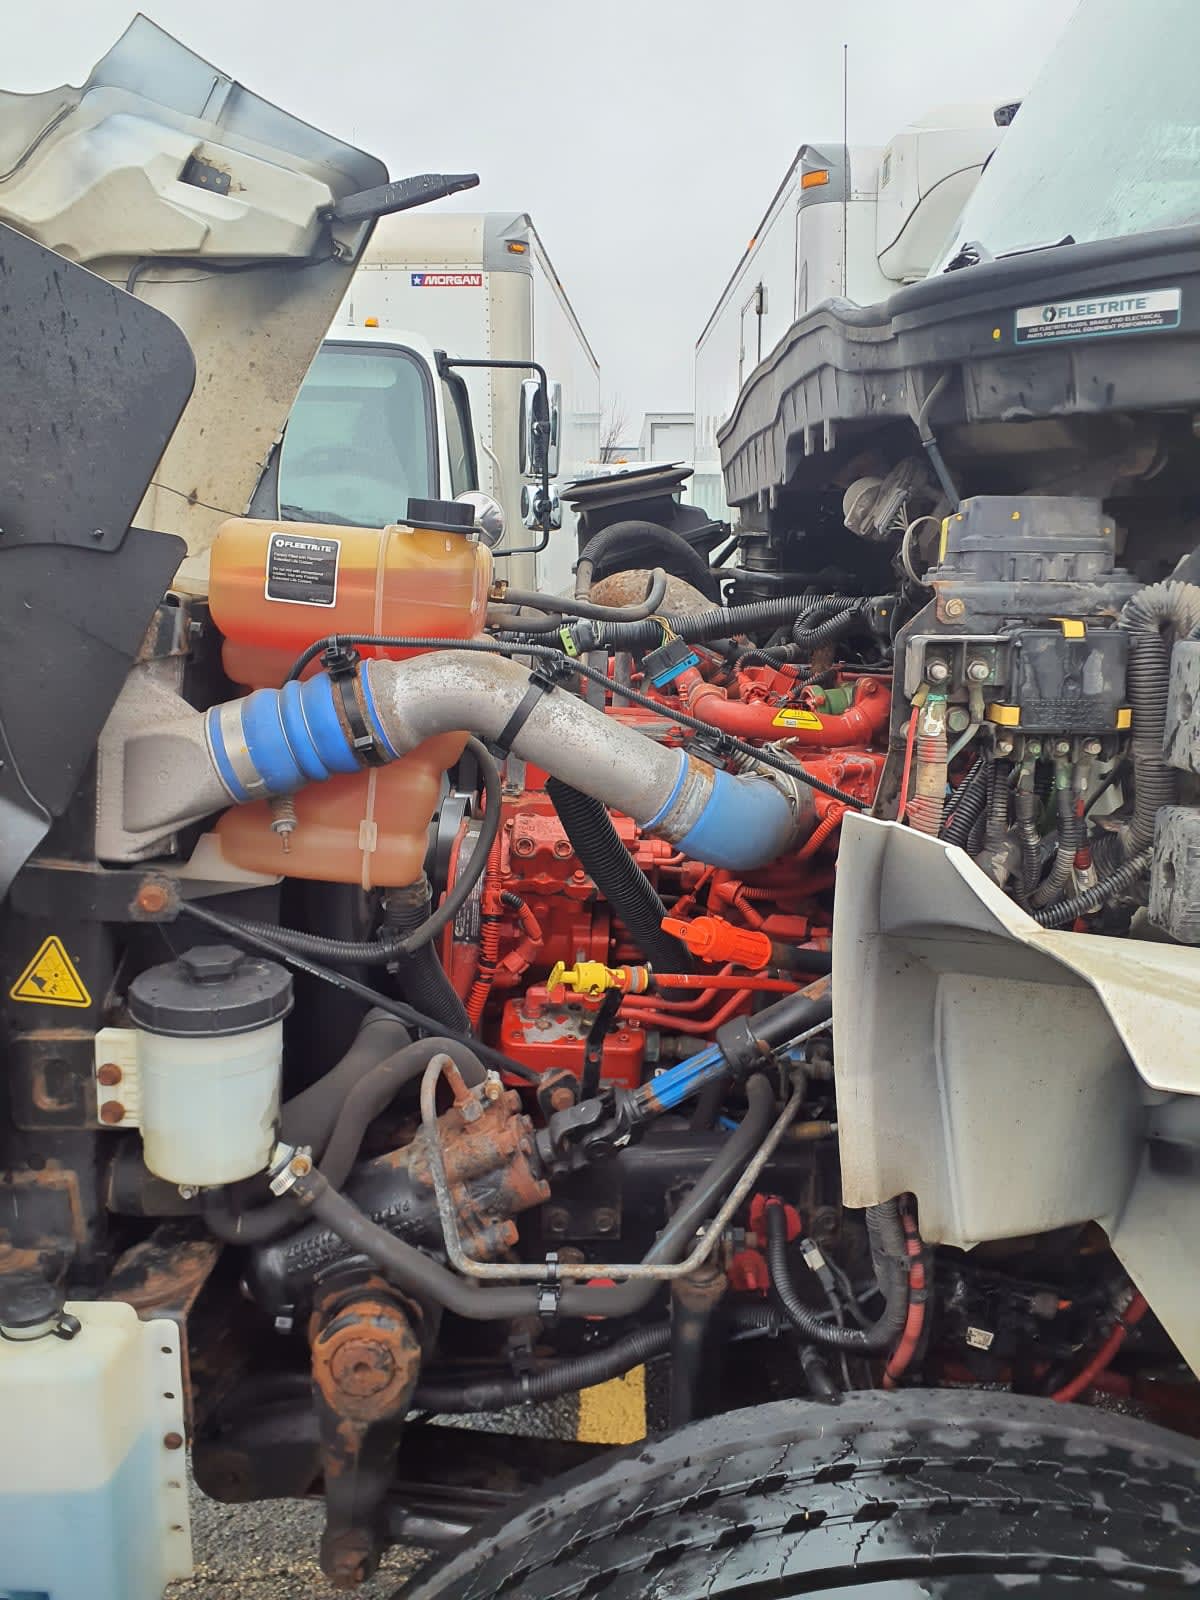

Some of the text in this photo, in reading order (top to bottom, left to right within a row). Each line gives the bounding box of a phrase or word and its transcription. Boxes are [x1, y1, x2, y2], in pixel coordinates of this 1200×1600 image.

[424, 275, 480, 285] MORGAN
[1058, 298, 1146, 318] FLEETRITE
[1125, 313, 1162, 322] ELECTRICAL
